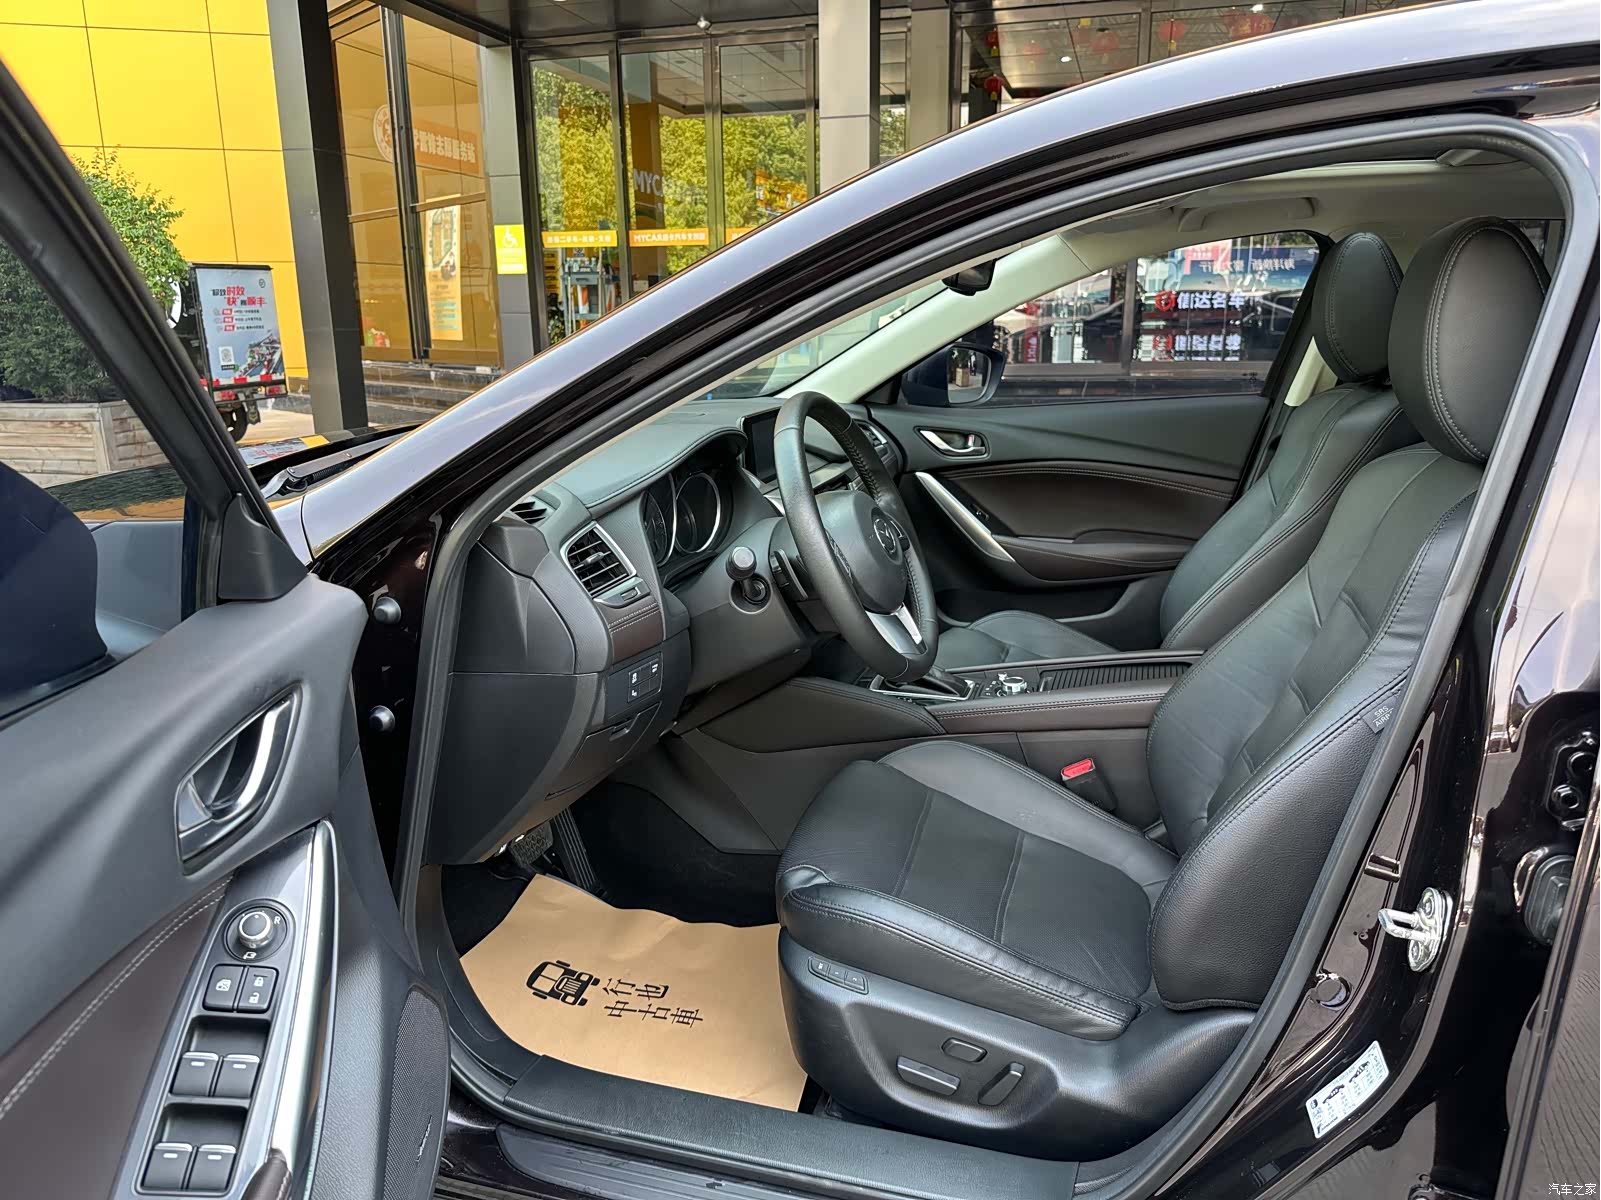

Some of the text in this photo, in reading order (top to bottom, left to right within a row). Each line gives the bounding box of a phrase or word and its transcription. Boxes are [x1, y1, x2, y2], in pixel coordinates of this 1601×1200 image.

[1177, 291, 1245, 309] 信达名车
[1374, 706, 1389, 717] SRS
[604, 1000, 703, 1028] 中古車
